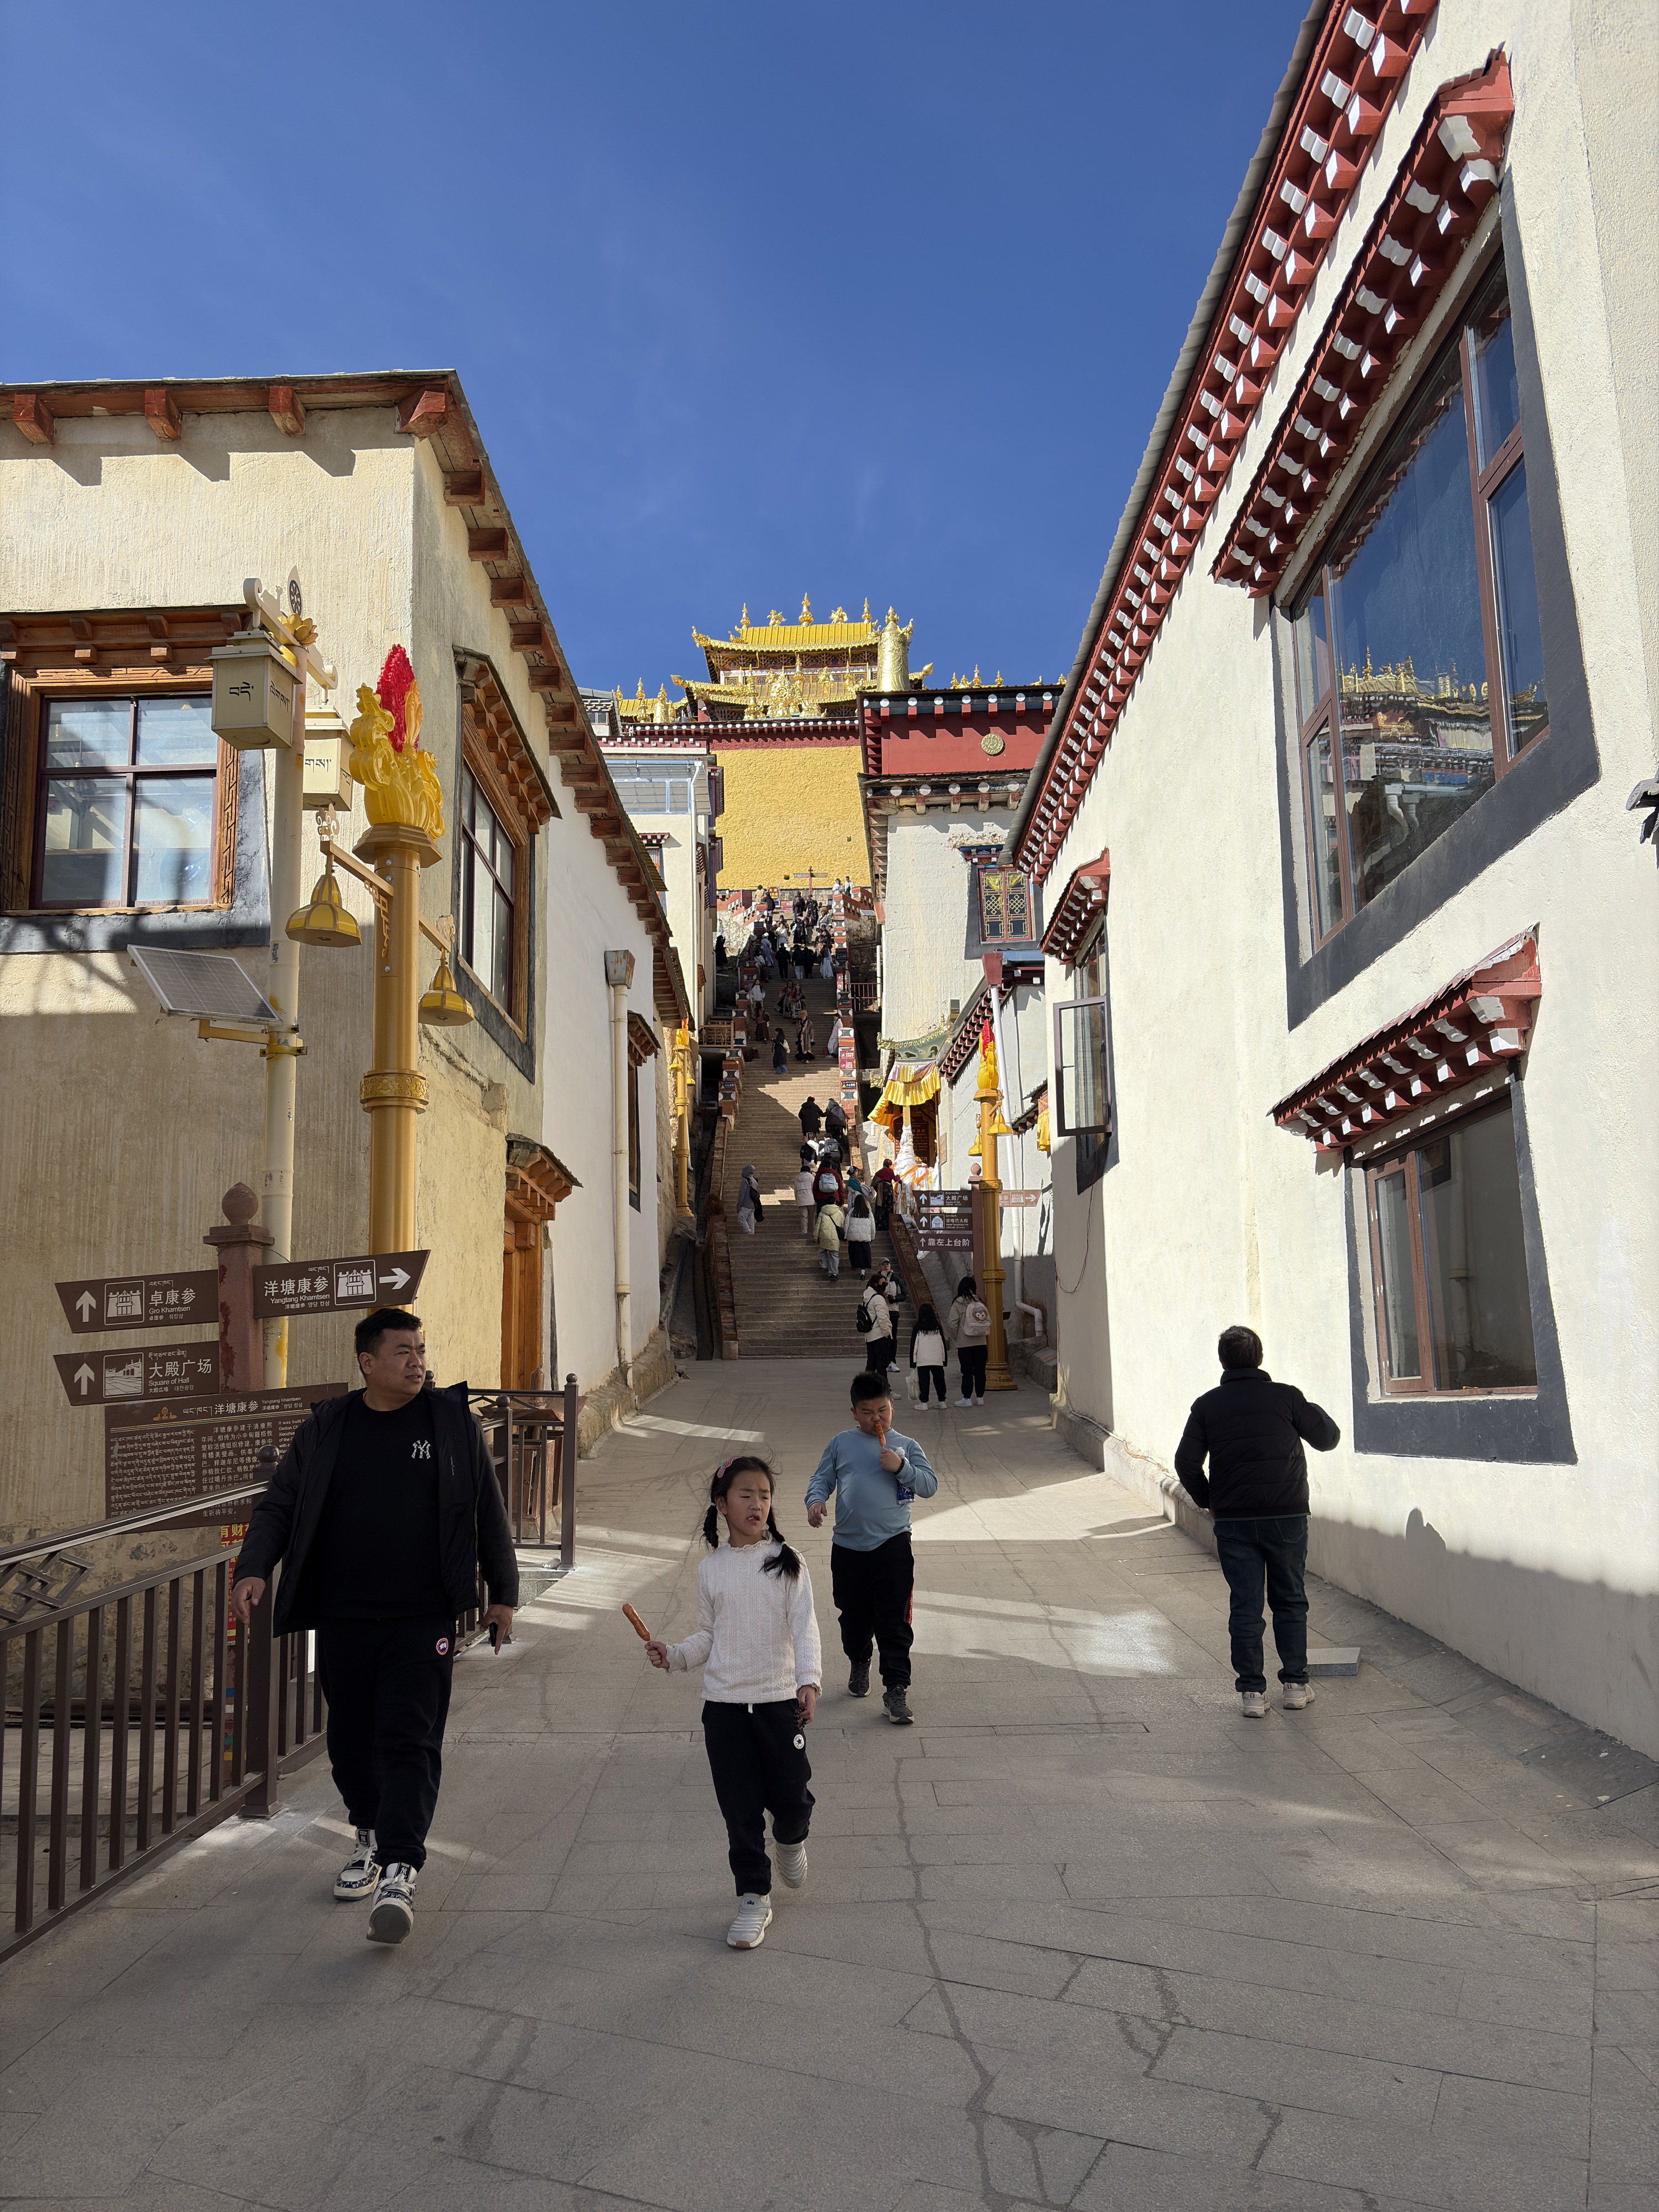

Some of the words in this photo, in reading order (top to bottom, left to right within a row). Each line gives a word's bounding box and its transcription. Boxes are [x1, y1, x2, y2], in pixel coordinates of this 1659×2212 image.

[927, 1238, 970, 1246] 靠左上台阶
[264, 1275, 328, 1297] 洋塘康参
[149, 1287, 196, 1306] 卓康参
[149, 1358, 212, 1379] 大殿广场
[215, 1400, 259, 1415] 洋塘康参
[213, 1422, 273, 1433] 洋塘康参建于清康熙
[411, 1439, 431, 1460] NY
[202, 1508, 237, 1517] 生祈祷平安。
